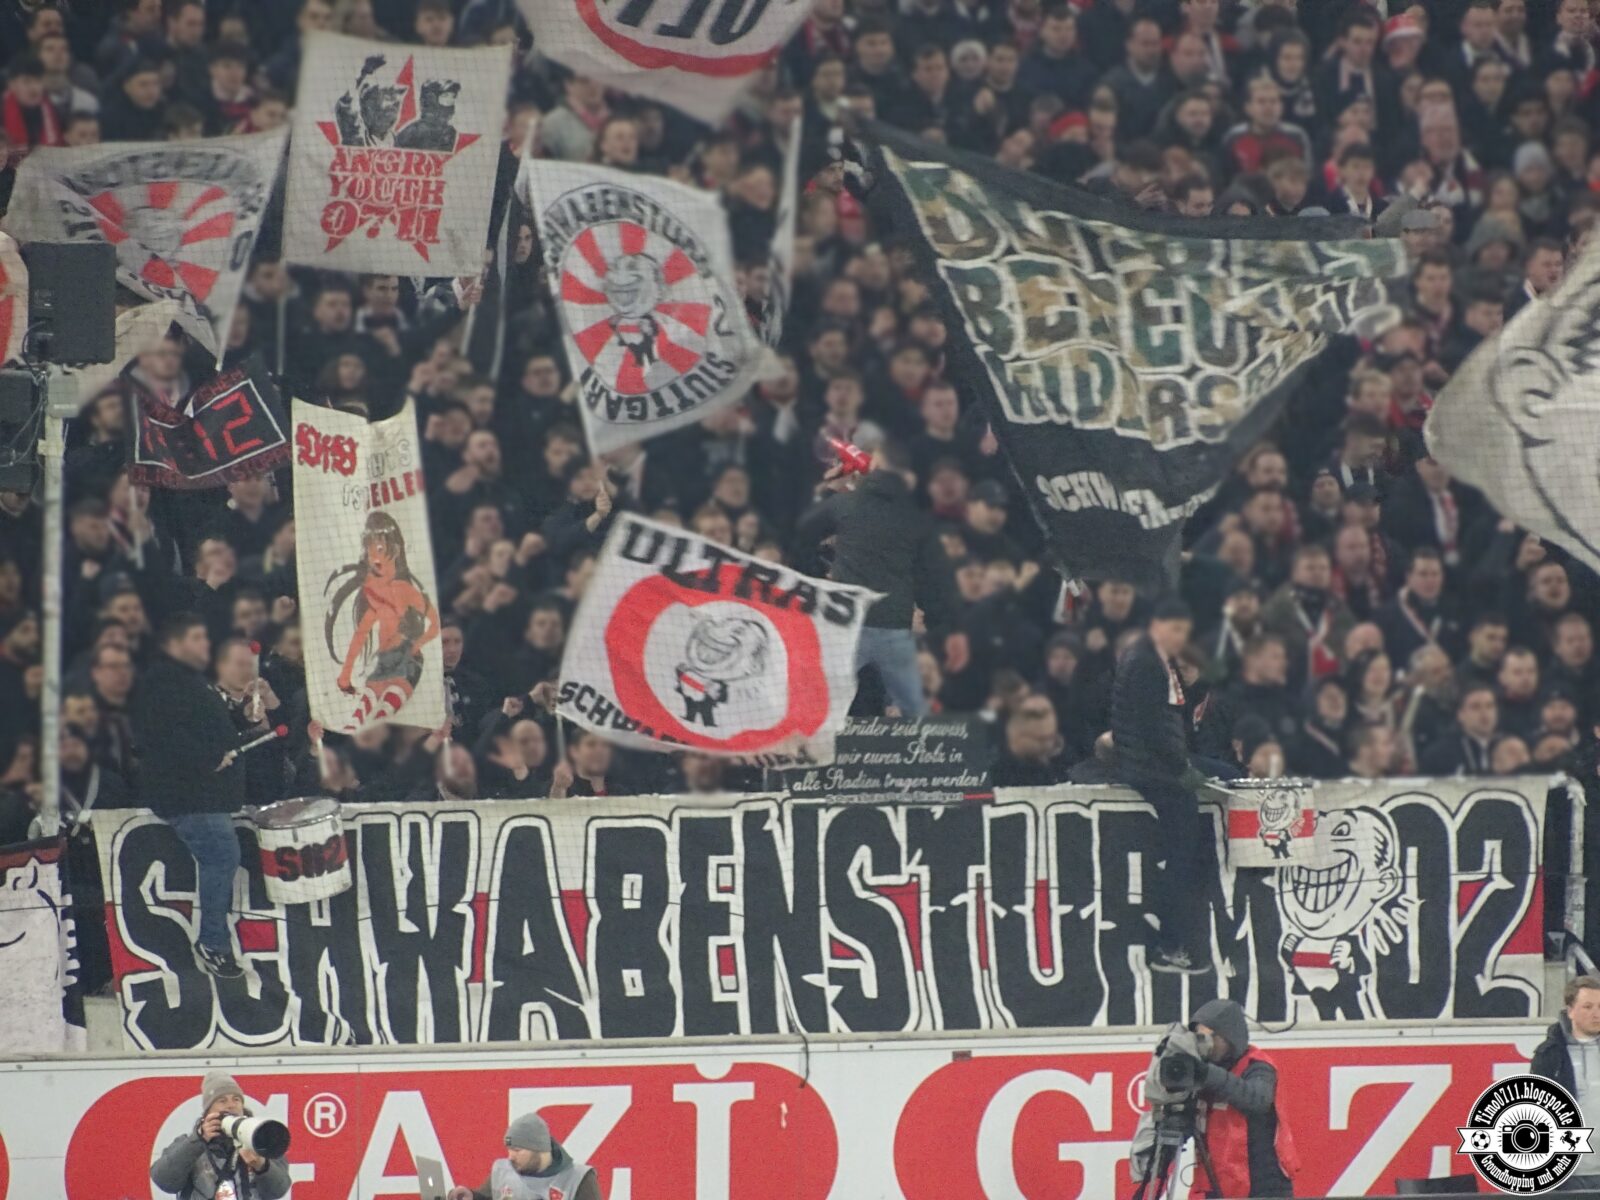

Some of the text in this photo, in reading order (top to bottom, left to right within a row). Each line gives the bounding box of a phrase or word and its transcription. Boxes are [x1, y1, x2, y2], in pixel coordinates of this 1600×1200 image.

[329, 147, 452, 177] ANGRY
[329, 174, 446, 206] YOUTH
[620, 521, 858, 627] ULTRAS
[948, 747, 964, 763] in
[792, 770, 821, 792] alle
[883, 772, 928, 793] tragen
